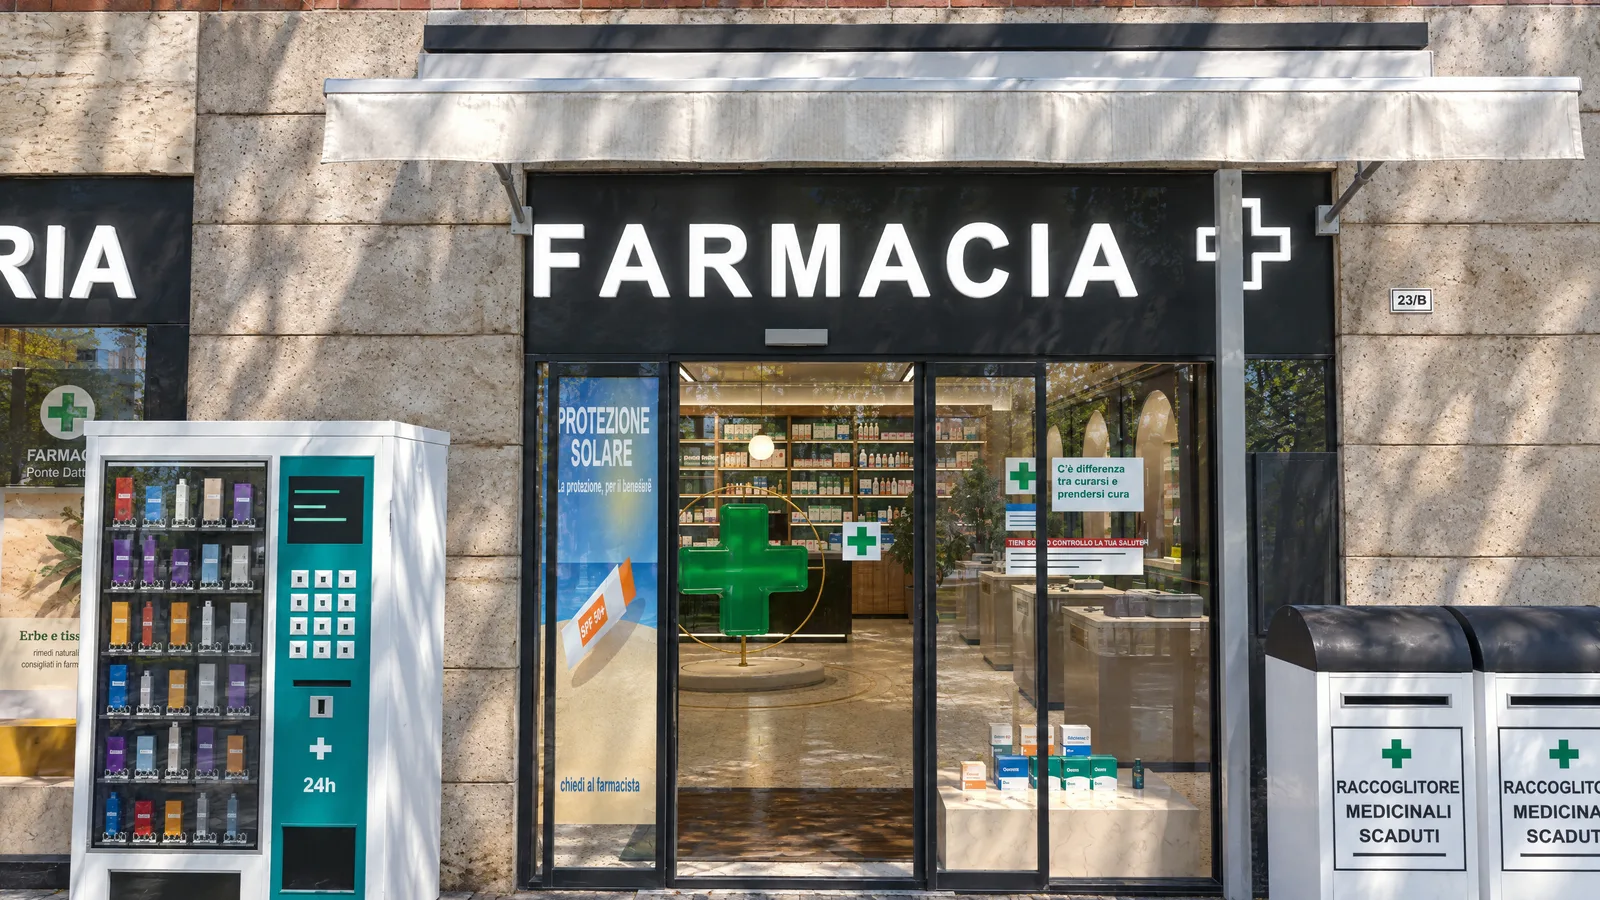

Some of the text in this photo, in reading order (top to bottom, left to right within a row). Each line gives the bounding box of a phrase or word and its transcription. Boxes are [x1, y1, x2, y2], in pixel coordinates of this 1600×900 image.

[0, 225, 137, 298] RIA
[532, 223, 1138, 298] FARMACIA
[1397, 295, 1427, 305] 23/B
[559, 406, 650, 434] PROTEZIONE
[571, 439, 633, 467] SOLARE
[26, 467, 59, 477] Ponte
[1076, 464, 1125, 473] differenza
[566, 479, 604, 495] protezione,
[605, 482, 615, 496] per
[1057, 477, 1072, 486] tra
[1075, 477, 1109, 486] curarsi
[1057, 490, 1130, 500] prendersi cura
[580, 605, 605, 638] SPF 50+
[19, 630, 80, 641] Erbe e tiss
[33, 649, 79, 657] rimedi naturali
[21, 661, 54, 670] consigliati
[303, 777, 336, 793] 24h
[560, 776, 640, 792] chiedi al farmacista
[1336, 780, 1460, 794] RACCOGLITORE
[1346, 804, 1451, 819] MEDICINALI
[1513, 805, 1600, 819] MEDICINA
[1359, 829, 1440, 843] SCADUTI
[1527, 829, 1600, 843] SCADUT
